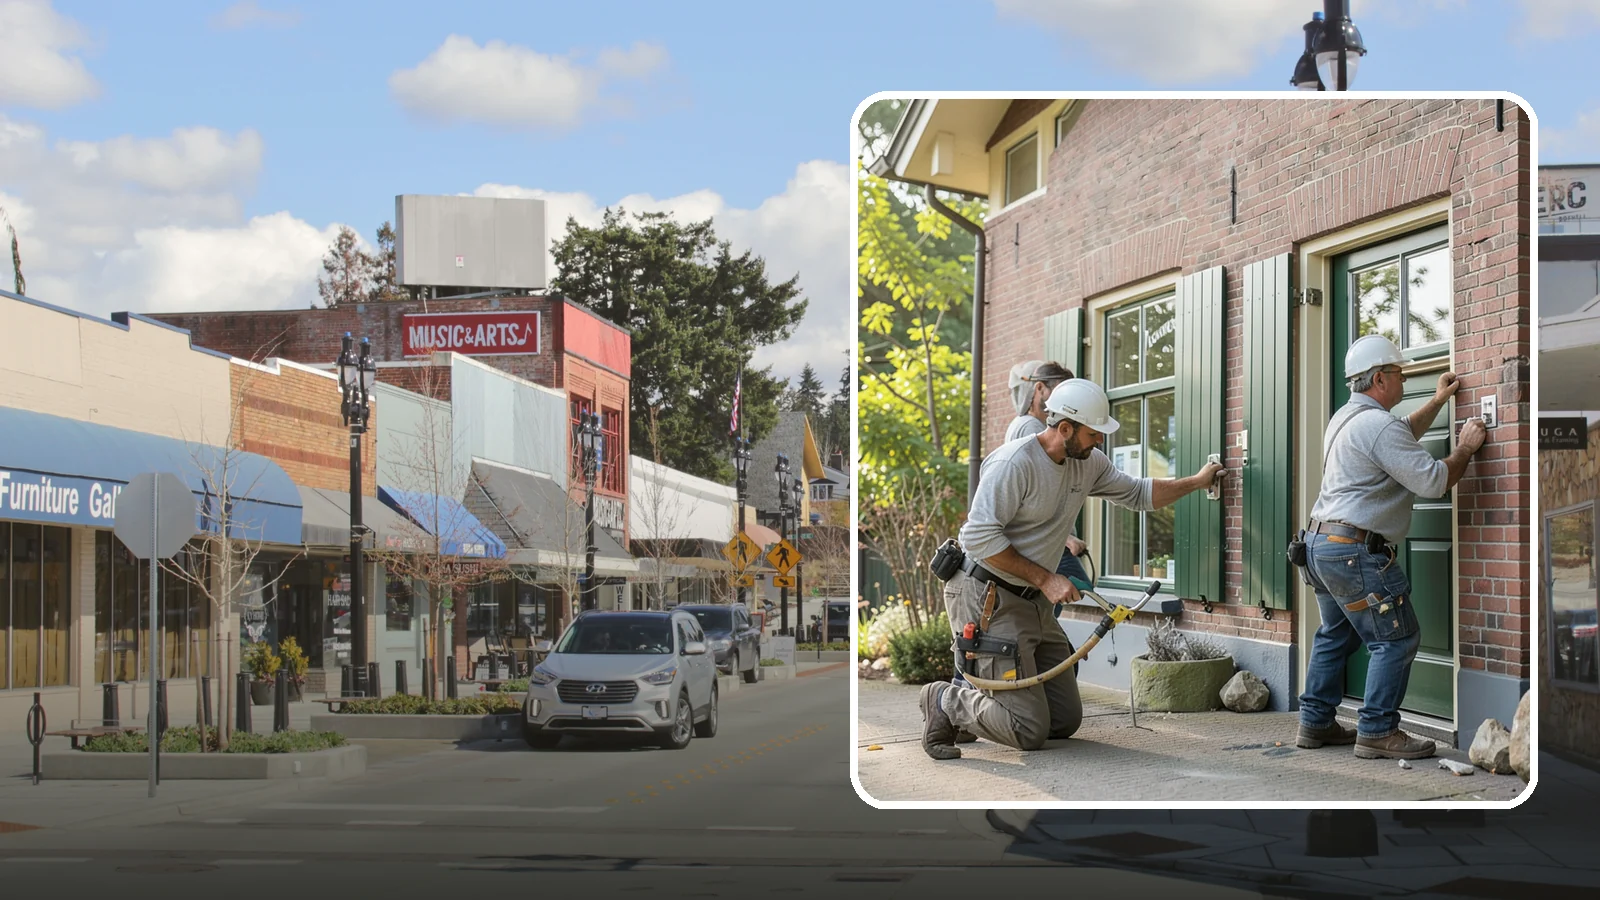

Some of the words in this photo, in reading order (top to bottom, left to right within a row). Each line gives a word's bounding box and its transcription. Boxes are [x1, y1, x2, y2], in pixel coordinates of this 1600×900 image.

[409, 323, 519, 348] MUSIC&ARTS
[0, 471, 79, 515] Furniture
[453, 563, 479, 574] SUSHI
